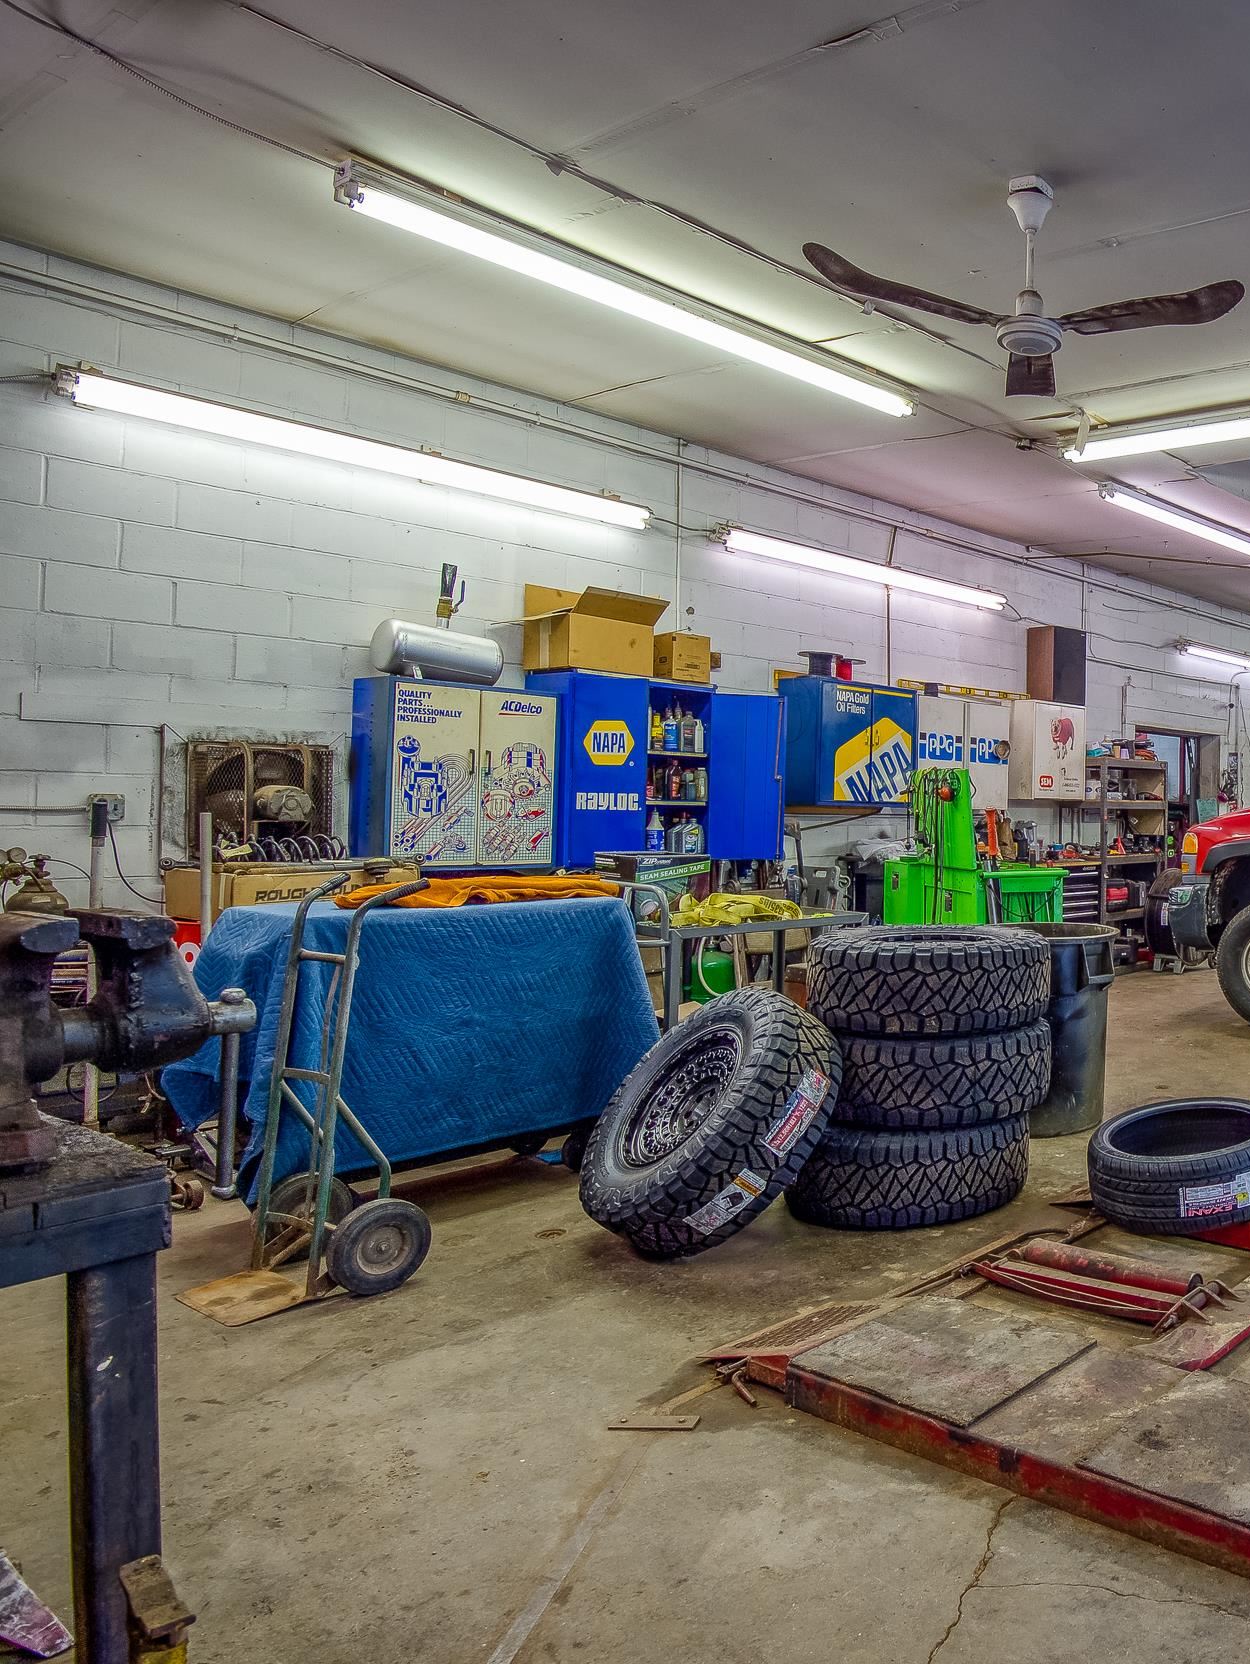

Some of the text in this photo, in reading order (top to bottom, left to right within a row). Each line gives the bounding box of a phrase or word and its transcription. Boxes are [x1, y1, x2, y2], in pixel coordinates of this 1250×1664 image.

[398, 689, 432, 699] QUALITY
[837, 691, 869, 704] NAPA Gold
[397, 706, 462, 718] PROFESSIONALLY
[501, 700, 542, 715] ACDelco
[836, 702, 866, 715] Oil Filters
[397, 714, 436, 724] INSTALLED
[592, 732, 626, 753] NAPA
[928, 733, 953, 757] PPG
[845, 741, 911, 801] NAPA
[640, 864, 705, 881] SEAM SEALING TAPE
